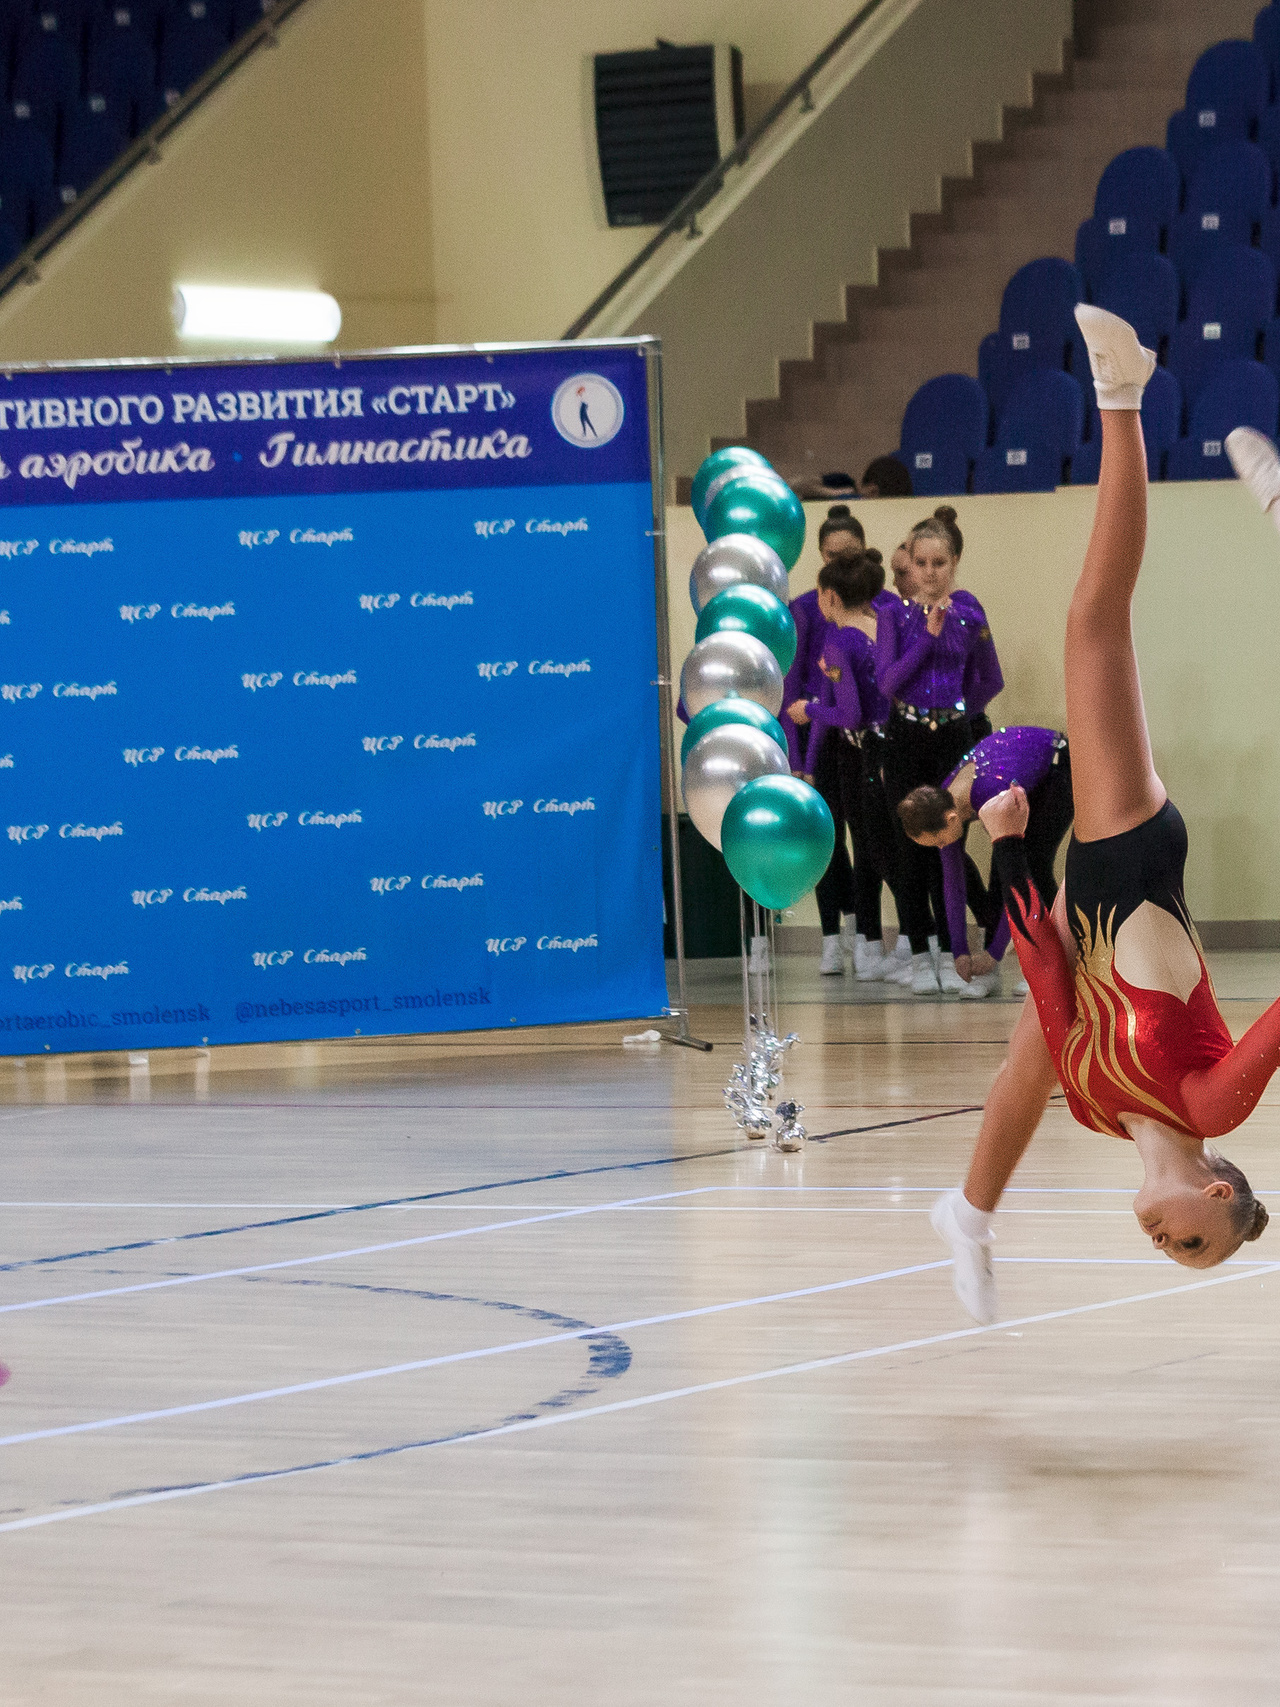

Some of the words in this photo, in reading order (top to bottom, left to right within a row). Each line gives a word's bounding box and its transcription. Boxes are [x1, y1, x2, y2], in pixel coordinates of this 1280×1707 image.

[0, 395, 165, 430] ТИВНОГО
[172, 389, 364, 424] РАЗВИТИЯ
[372, 383, 516, 416] «СТАРТ»
[259, 429, 532, 468] Гимнастика
[18, 437, 216, 490] аэробика
[525, 518, 588, 536] Старт
[289, 528, 354, 547] Старт
[49, 538, 114, 557] Старт
[410, 591, 474, 610] Старт
[171, 602, 235, 621] Старт
[528, 660, 591, 678] Старт
[293, 670, 357, 689] Старт
[52, 681, 117, 700] Старт
[413, 733, 476, 752] Старт
[174, 745, 239, 764] Старт
[533, 798, 595, 816] Старт
[298, 810, 362, 829] Старт
[59, 821, 123, 841] Старт
[421, 873, 484, 891] Старт
[182, 886, 247, 905] Старт
[536, 934, 598, 952] Старт
[303, 947, 366, 966] Старт
[65, 961, 129, 980] Старт
[236, 987, 492, 1024] @nebesasport_smolensk
